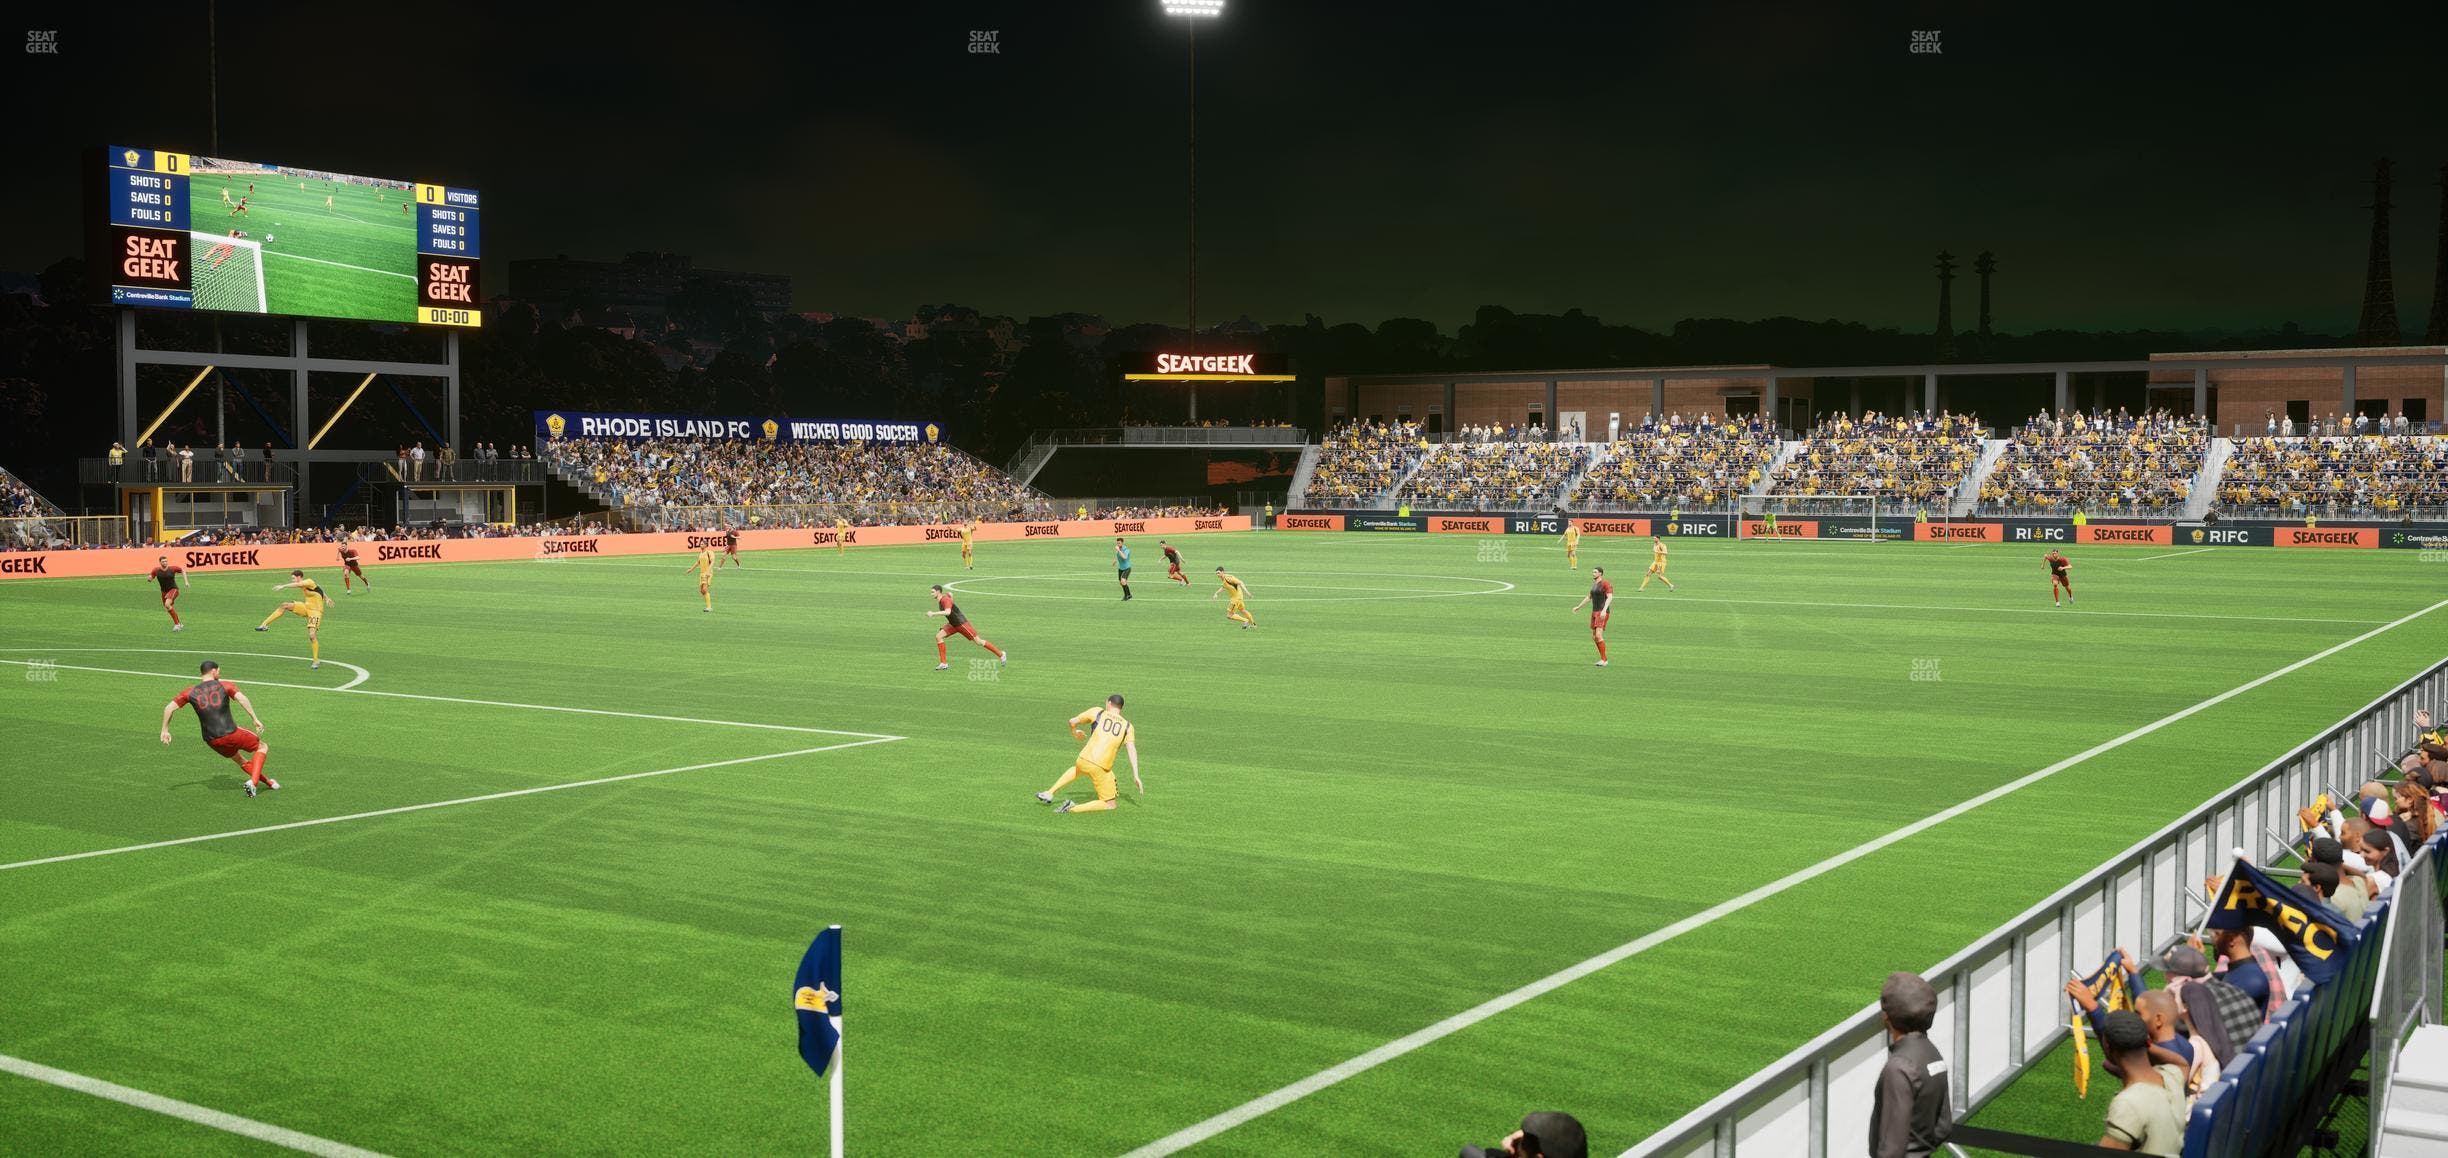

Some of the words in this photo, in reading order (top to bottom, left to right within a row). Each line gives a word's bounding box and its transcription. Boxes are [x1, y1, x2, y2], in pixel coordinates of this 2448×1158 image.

[168, 155, 177, 172] 0
[130, 175, 160, 188] SHOTS
[165, 179, 171, 190] 0
[131, 192, 160, 205] SAVES
[165, 195, 171, 206] 0
[427, 187, 434, 202] 0
[447, 191, 478, 204] VISITORS
[131, 208, 160, 221] FOULS
[165, 211, 171, 222] 0
[432, 210, 456, 221] SHOTS
[459, 212, 465, 222] 0
[432, 224, 456, 235] SAVES
[459, 226, 465, 236] 0
[126, 236, 177, 259] SEAT
[432, 238, 456, 250] FOULS
[459, 241, 465, 251] 0
[124, 257, 180, 281] GEEK
[430, 263, 470, 283] SEAT
[428, 282, 472, 303] GEEK
[431, 309, 469, 324] 00:00
[1157, 353, 1255, 375] SEATGEEK
[581, 417, 652, 437] RHODE
[656, 419, 725, 438] ISLAND
[728, 421, 750, 438] FC
[791, 422, 839, 440] WICKED
[842, 423, 873, 441] GOOD
[876, 424, 919, 441] SOCCER
[1025, 524, 1059, 537] SEATGEEK
[1114, 522, 1145, 534] SEATGEEK
[1195, 520, 1223, 531] SEATGEEK
[1287, 518, 1331, 529] SEATGEEK
[1442, 520, 1490, 532] SEATGEEK
[1583, 522, 1635, 534] SEATGEEK
[1683, 523, 1718, 535] RIFC
[1930, 526, 1987, 540] SEATGEEK
[2094, 528, 2154, 542] SEATGEEK
[2209, 530, 2249, 543] RIFC
[2293, 531, 2360, 546] SEATGEEK
[378, 544, 442, 561] SEATGEEK
[543, 539, 599, 555] SEATGEEK
[0, 556, 47, 574] GEEK
[186, 549, 260, 569] SEATGEEK
[196, 691, 222, 709] 00
[1103, 718, 1122, 736] 00
